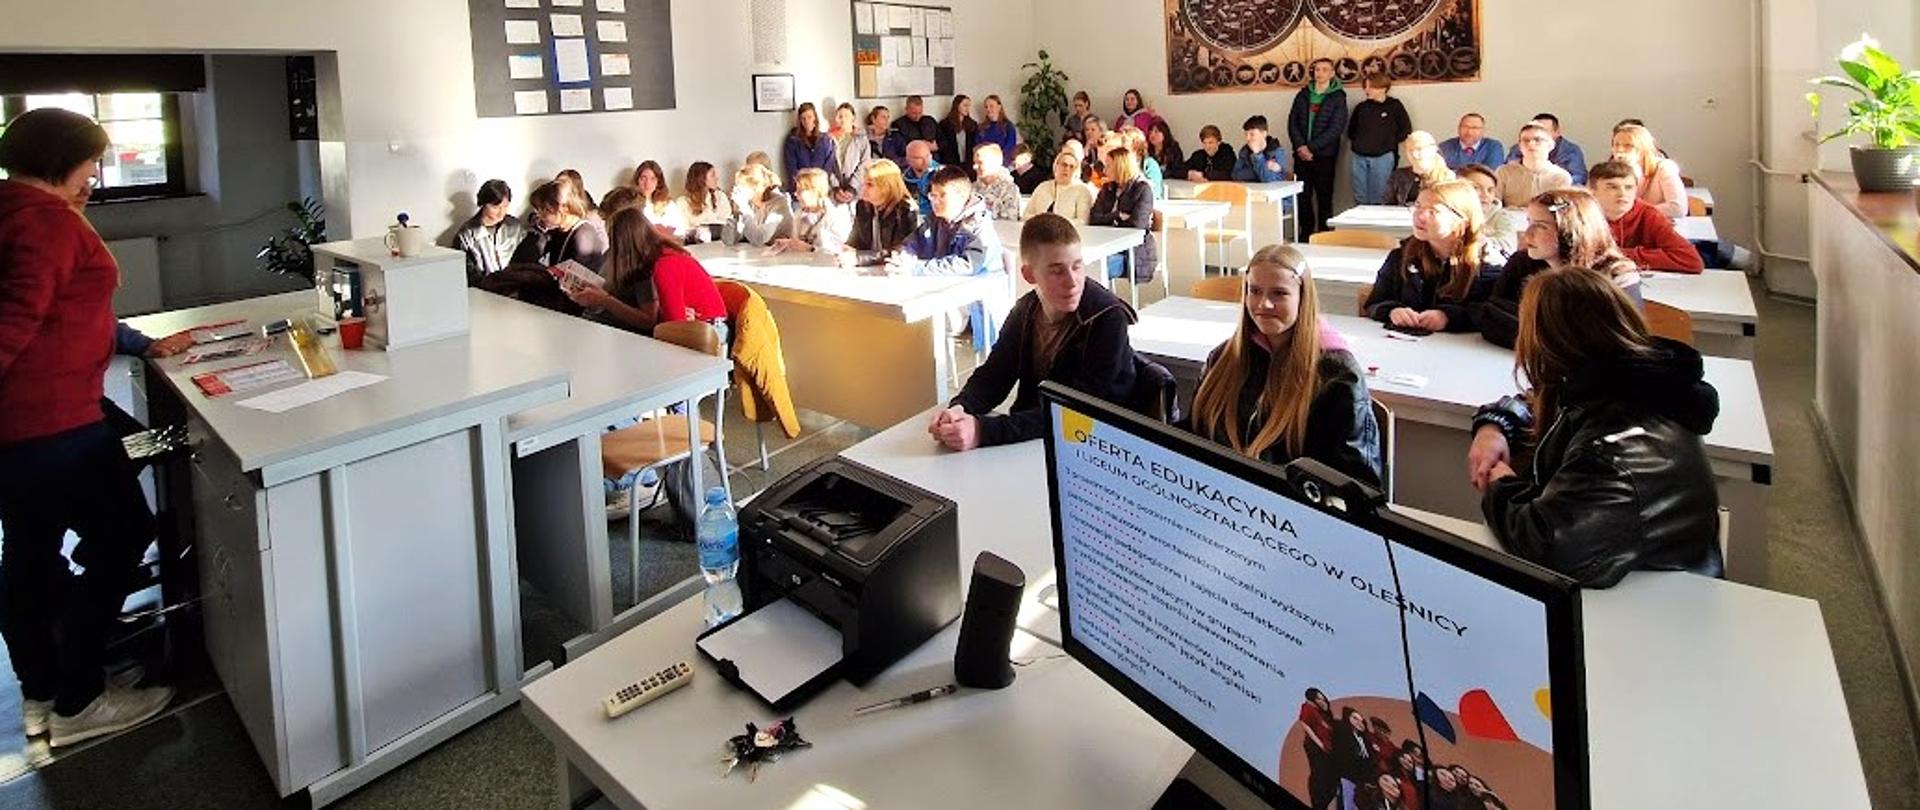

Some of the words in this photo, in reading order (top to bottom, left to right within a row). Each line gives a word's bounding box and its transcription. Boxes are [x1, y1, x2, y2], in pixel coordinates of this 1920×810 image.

[1073, 428, 1145, 470] OFERTA
[1081, 451, 1128, 480] LICEUM
[1206, 613, 1257, 649] grupach
[1269, 594, 1335, 637] wyższych
